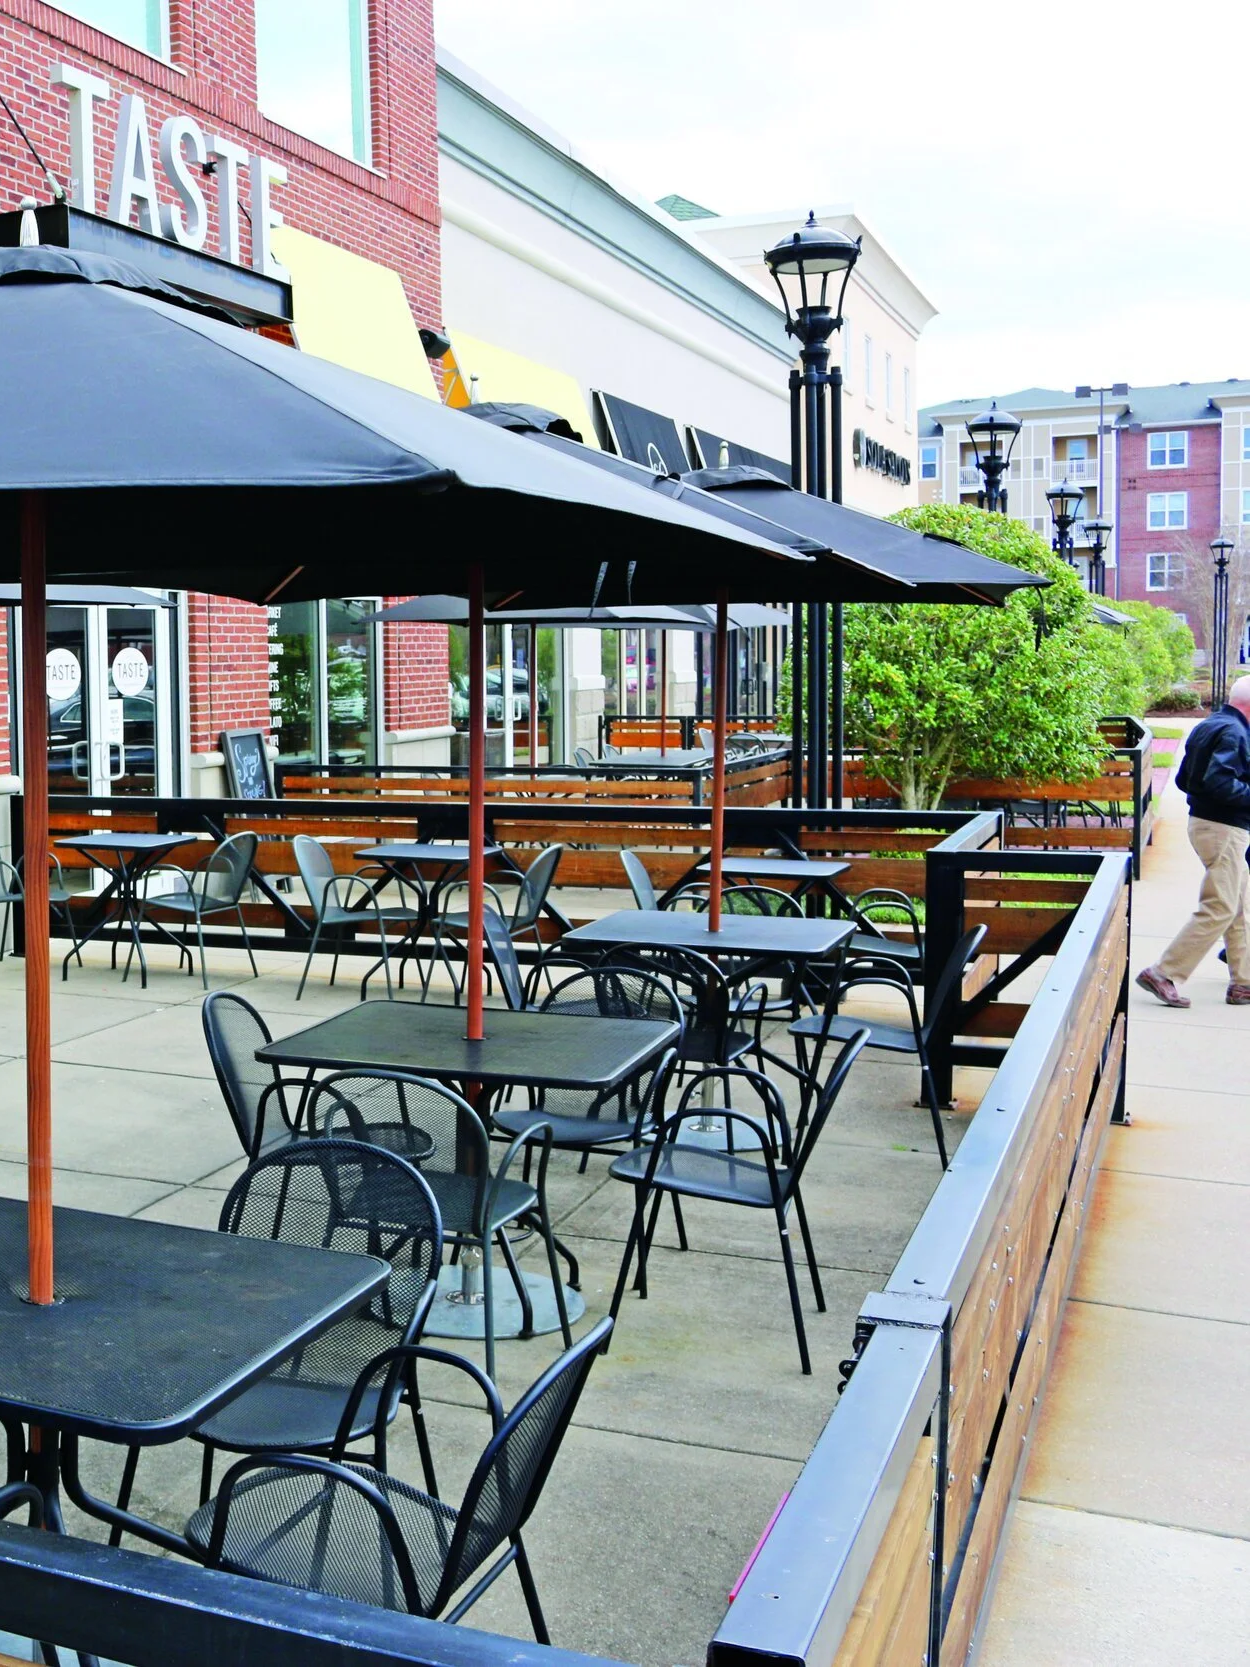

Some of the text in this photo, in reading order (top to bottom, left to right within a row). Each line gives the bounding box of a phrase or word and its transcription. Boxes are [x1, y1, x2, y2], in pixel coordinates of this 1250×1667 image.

[50, 63, 291, 284] TASTE
[46, 664, 76, 681] TASTE
[117, 663, 144, 679] TASTE
